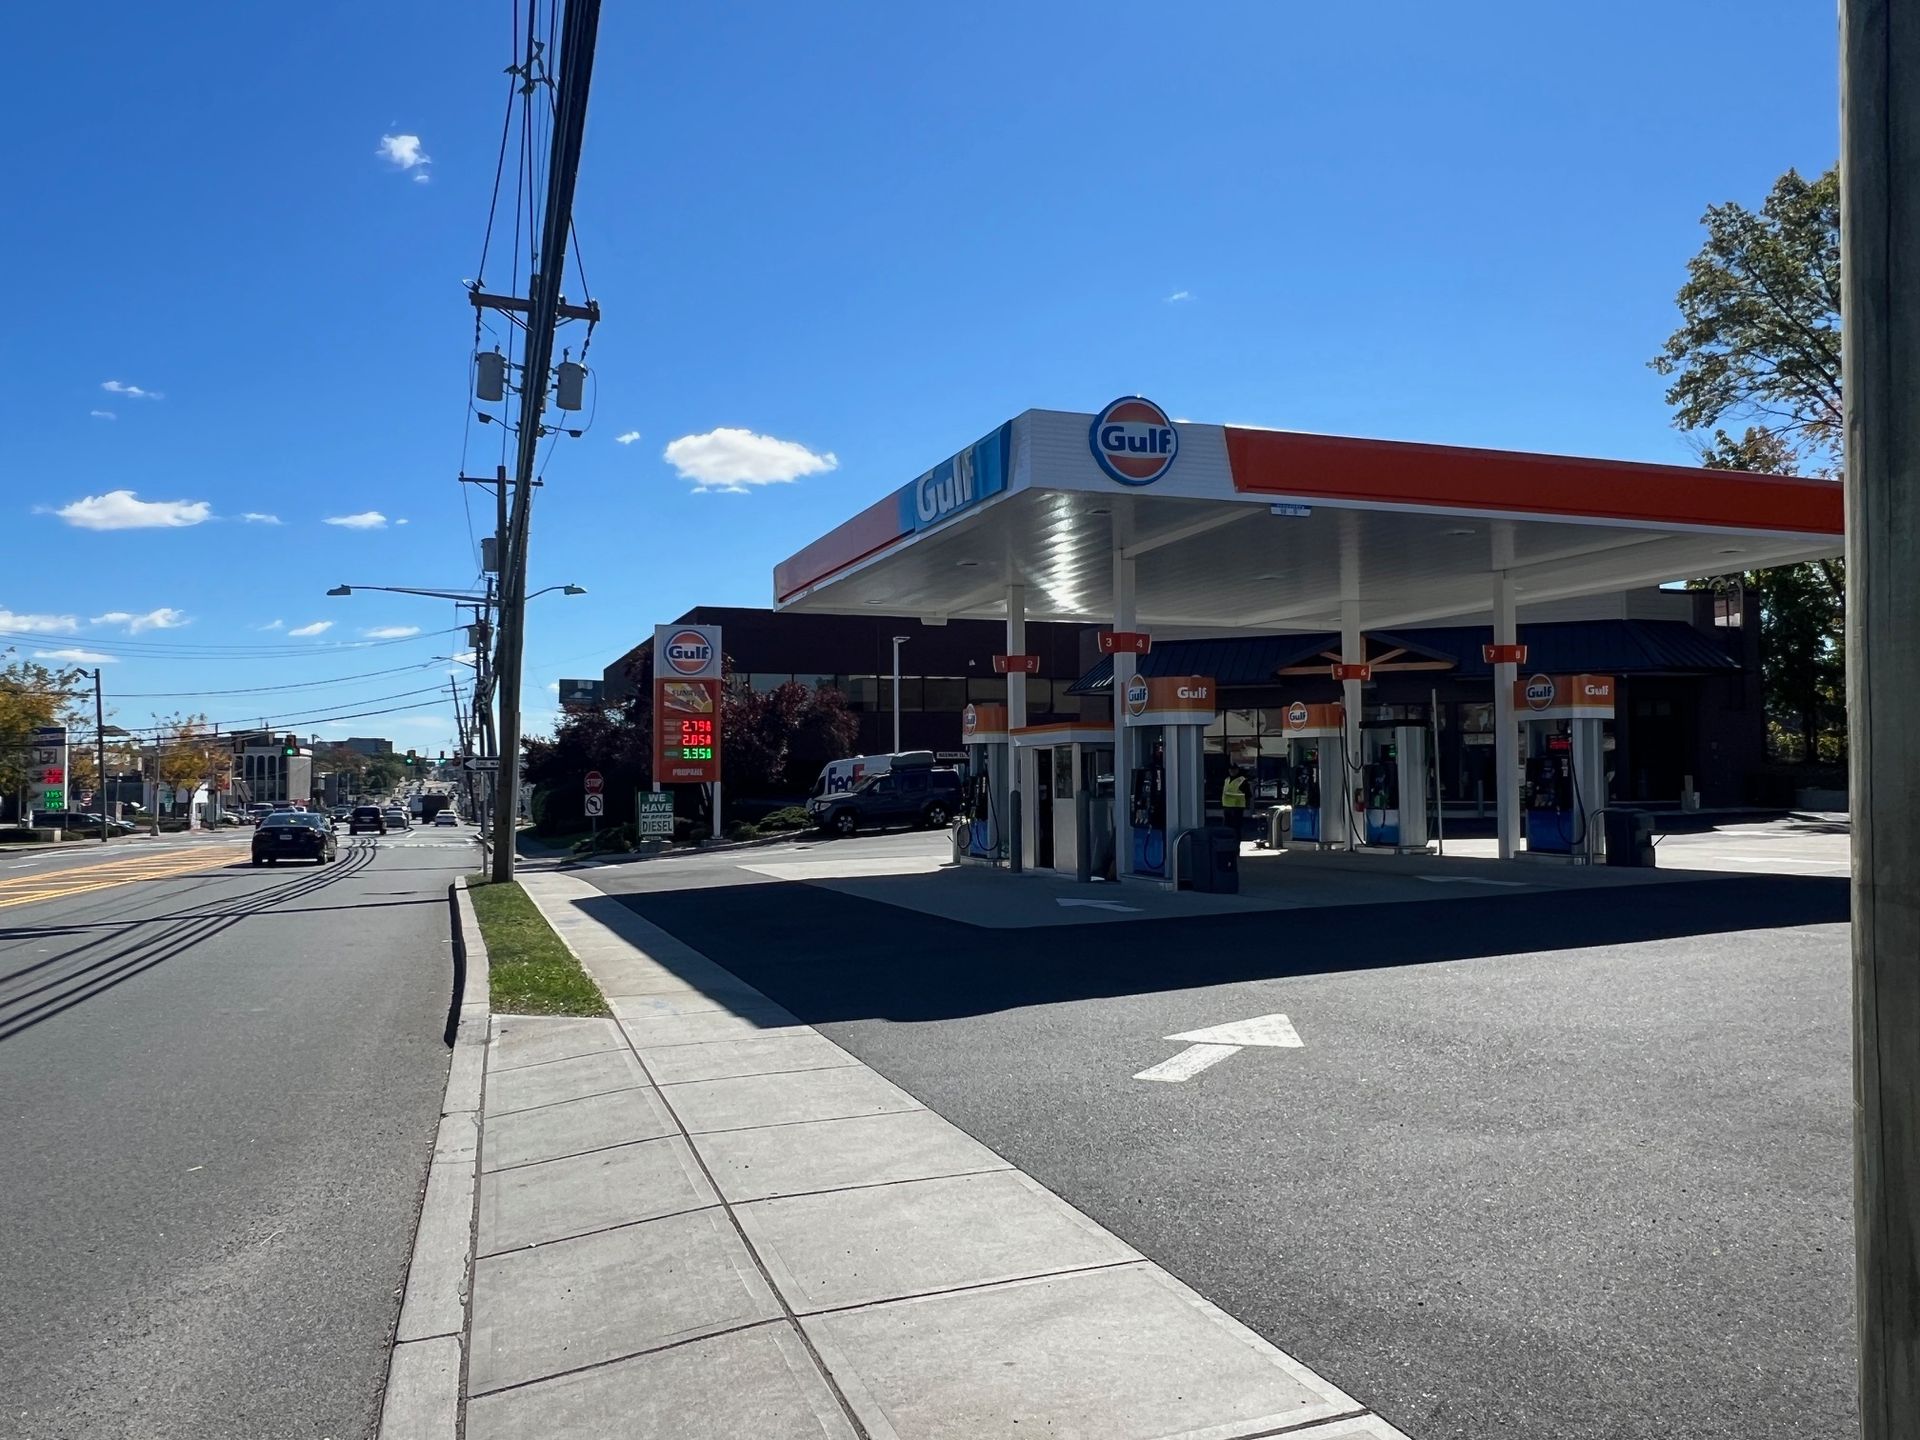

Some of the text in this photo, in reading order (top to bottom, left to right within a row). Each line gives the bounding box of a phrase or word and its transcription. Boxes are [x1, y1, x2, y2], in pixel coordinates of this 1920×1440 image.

[1101, 425, 1171, 454] Gulf
[916, 444, 974, 522] Gulf
[1105, 638, 1143, 648] 3 4
[668, 645, 710, 660] Gulf
[1489, 650, 1521, 659] 7 8
[1001, 660, 1033, 669] 1 2
[1337, 668, 1367, 676] 5 6
[1128, 687, 1147, 702] Gulf
[1177, 687, 1207, 699] Gulf
[1527, 686, 1552, 698] Gulf
[1585, 684, 1609, 696] Gulf
[1290, 711, 1306, 721] Gulf
[648, 793, 666, 802] WE
[641, 804, 673, 812] HAVE
[642, 821, 673, 832] DIESEL
